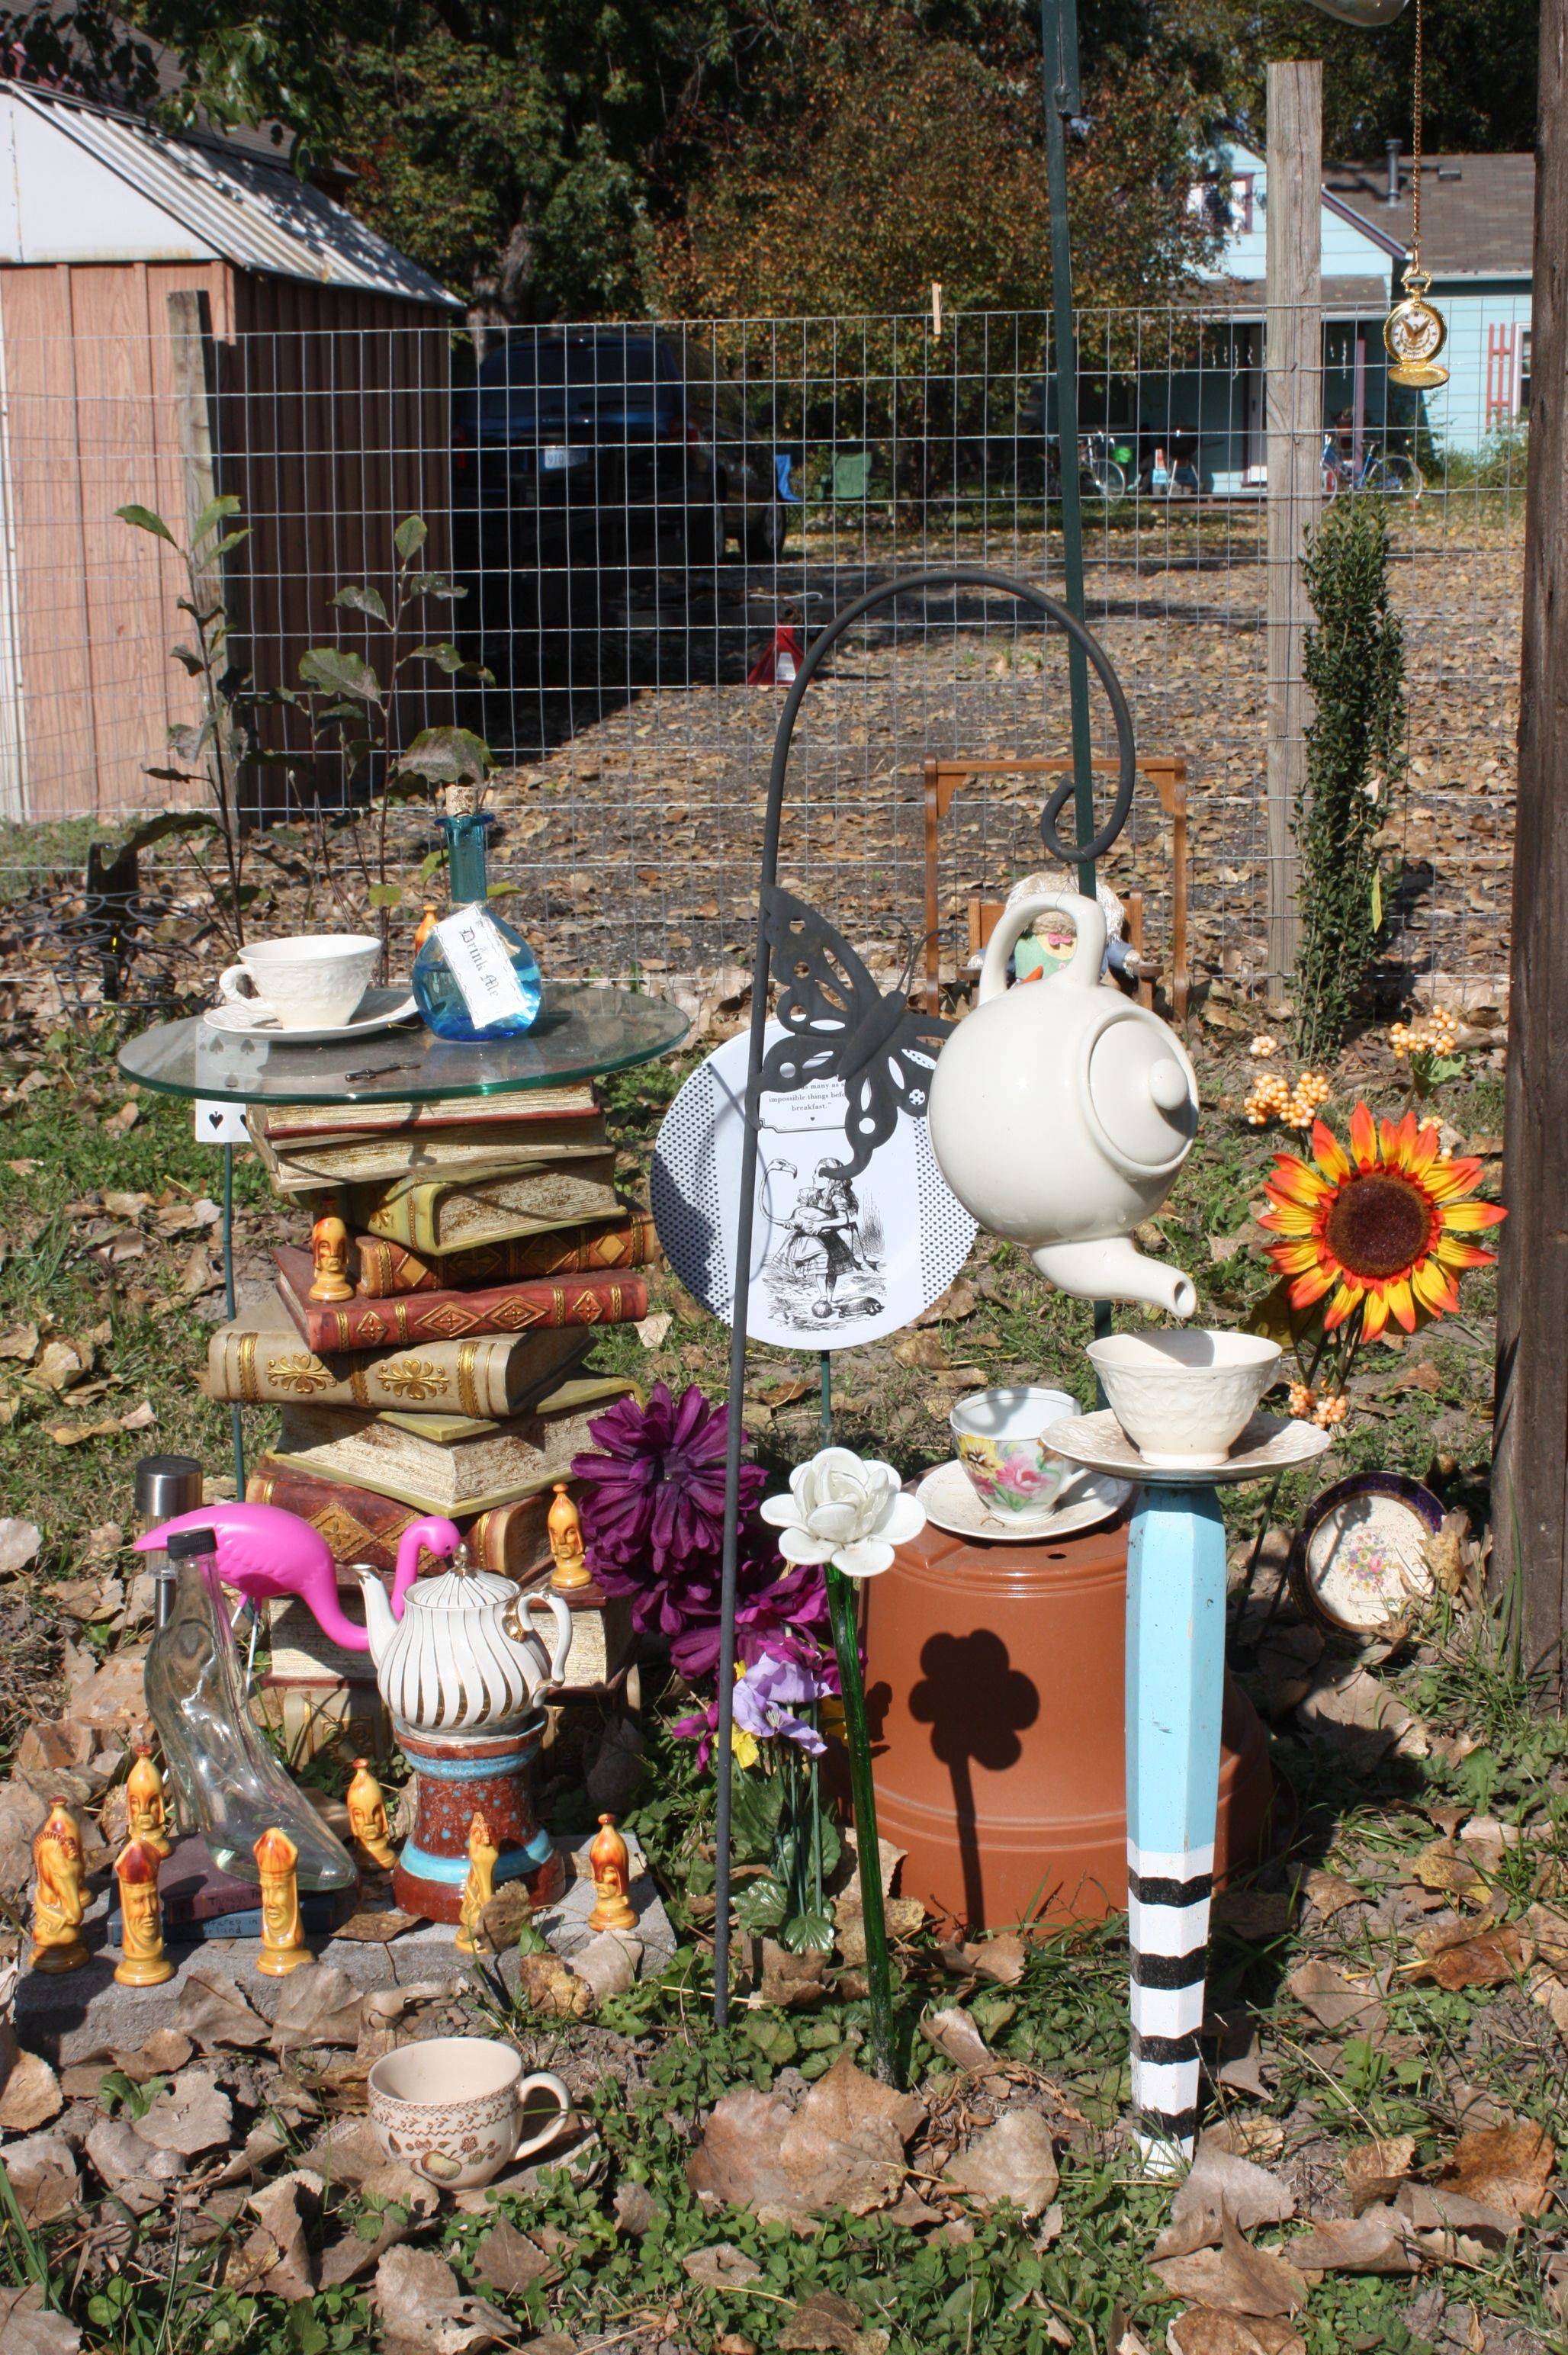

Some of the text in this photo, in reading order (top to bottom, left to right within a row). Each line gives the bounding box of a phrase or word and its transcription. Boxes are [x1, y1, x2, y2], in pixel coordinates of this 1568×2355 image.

[459, 925, 500, 997] Drink Me
[769, 1094, 805, 1104] impossible
